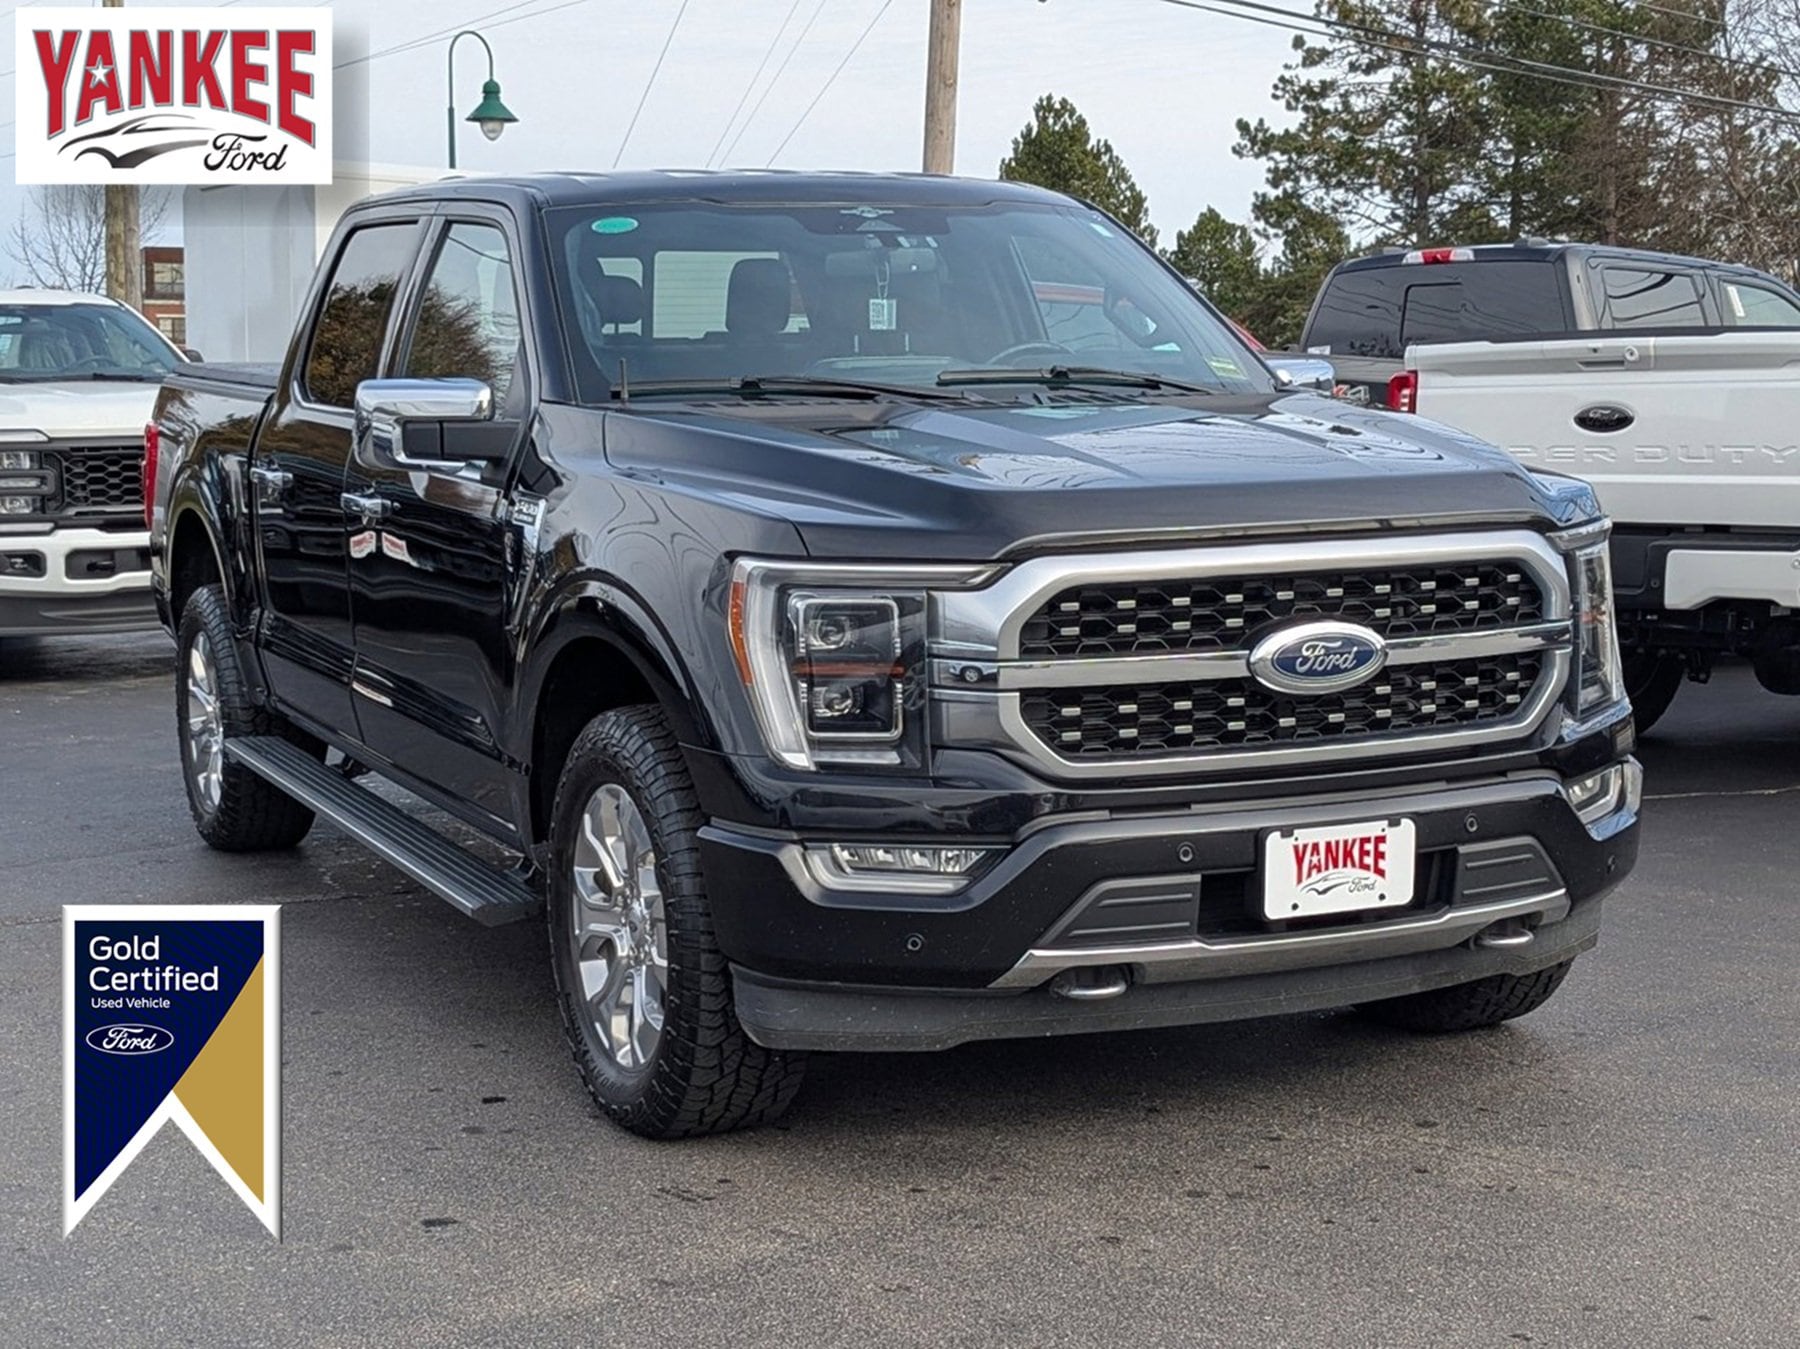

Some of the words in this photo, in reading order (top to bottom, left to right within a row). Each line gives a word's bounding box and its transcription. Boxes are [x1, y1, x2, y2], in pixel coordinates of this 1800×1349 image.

[1507, 444, 1616, 462] PER
[1633, 443, 1798, 463] DUTY
[1296, 641, 1358, 673] Ford
[1292, 834, 1388, 887] YANKEE
[1348, 877, 1378, 894] Ford
